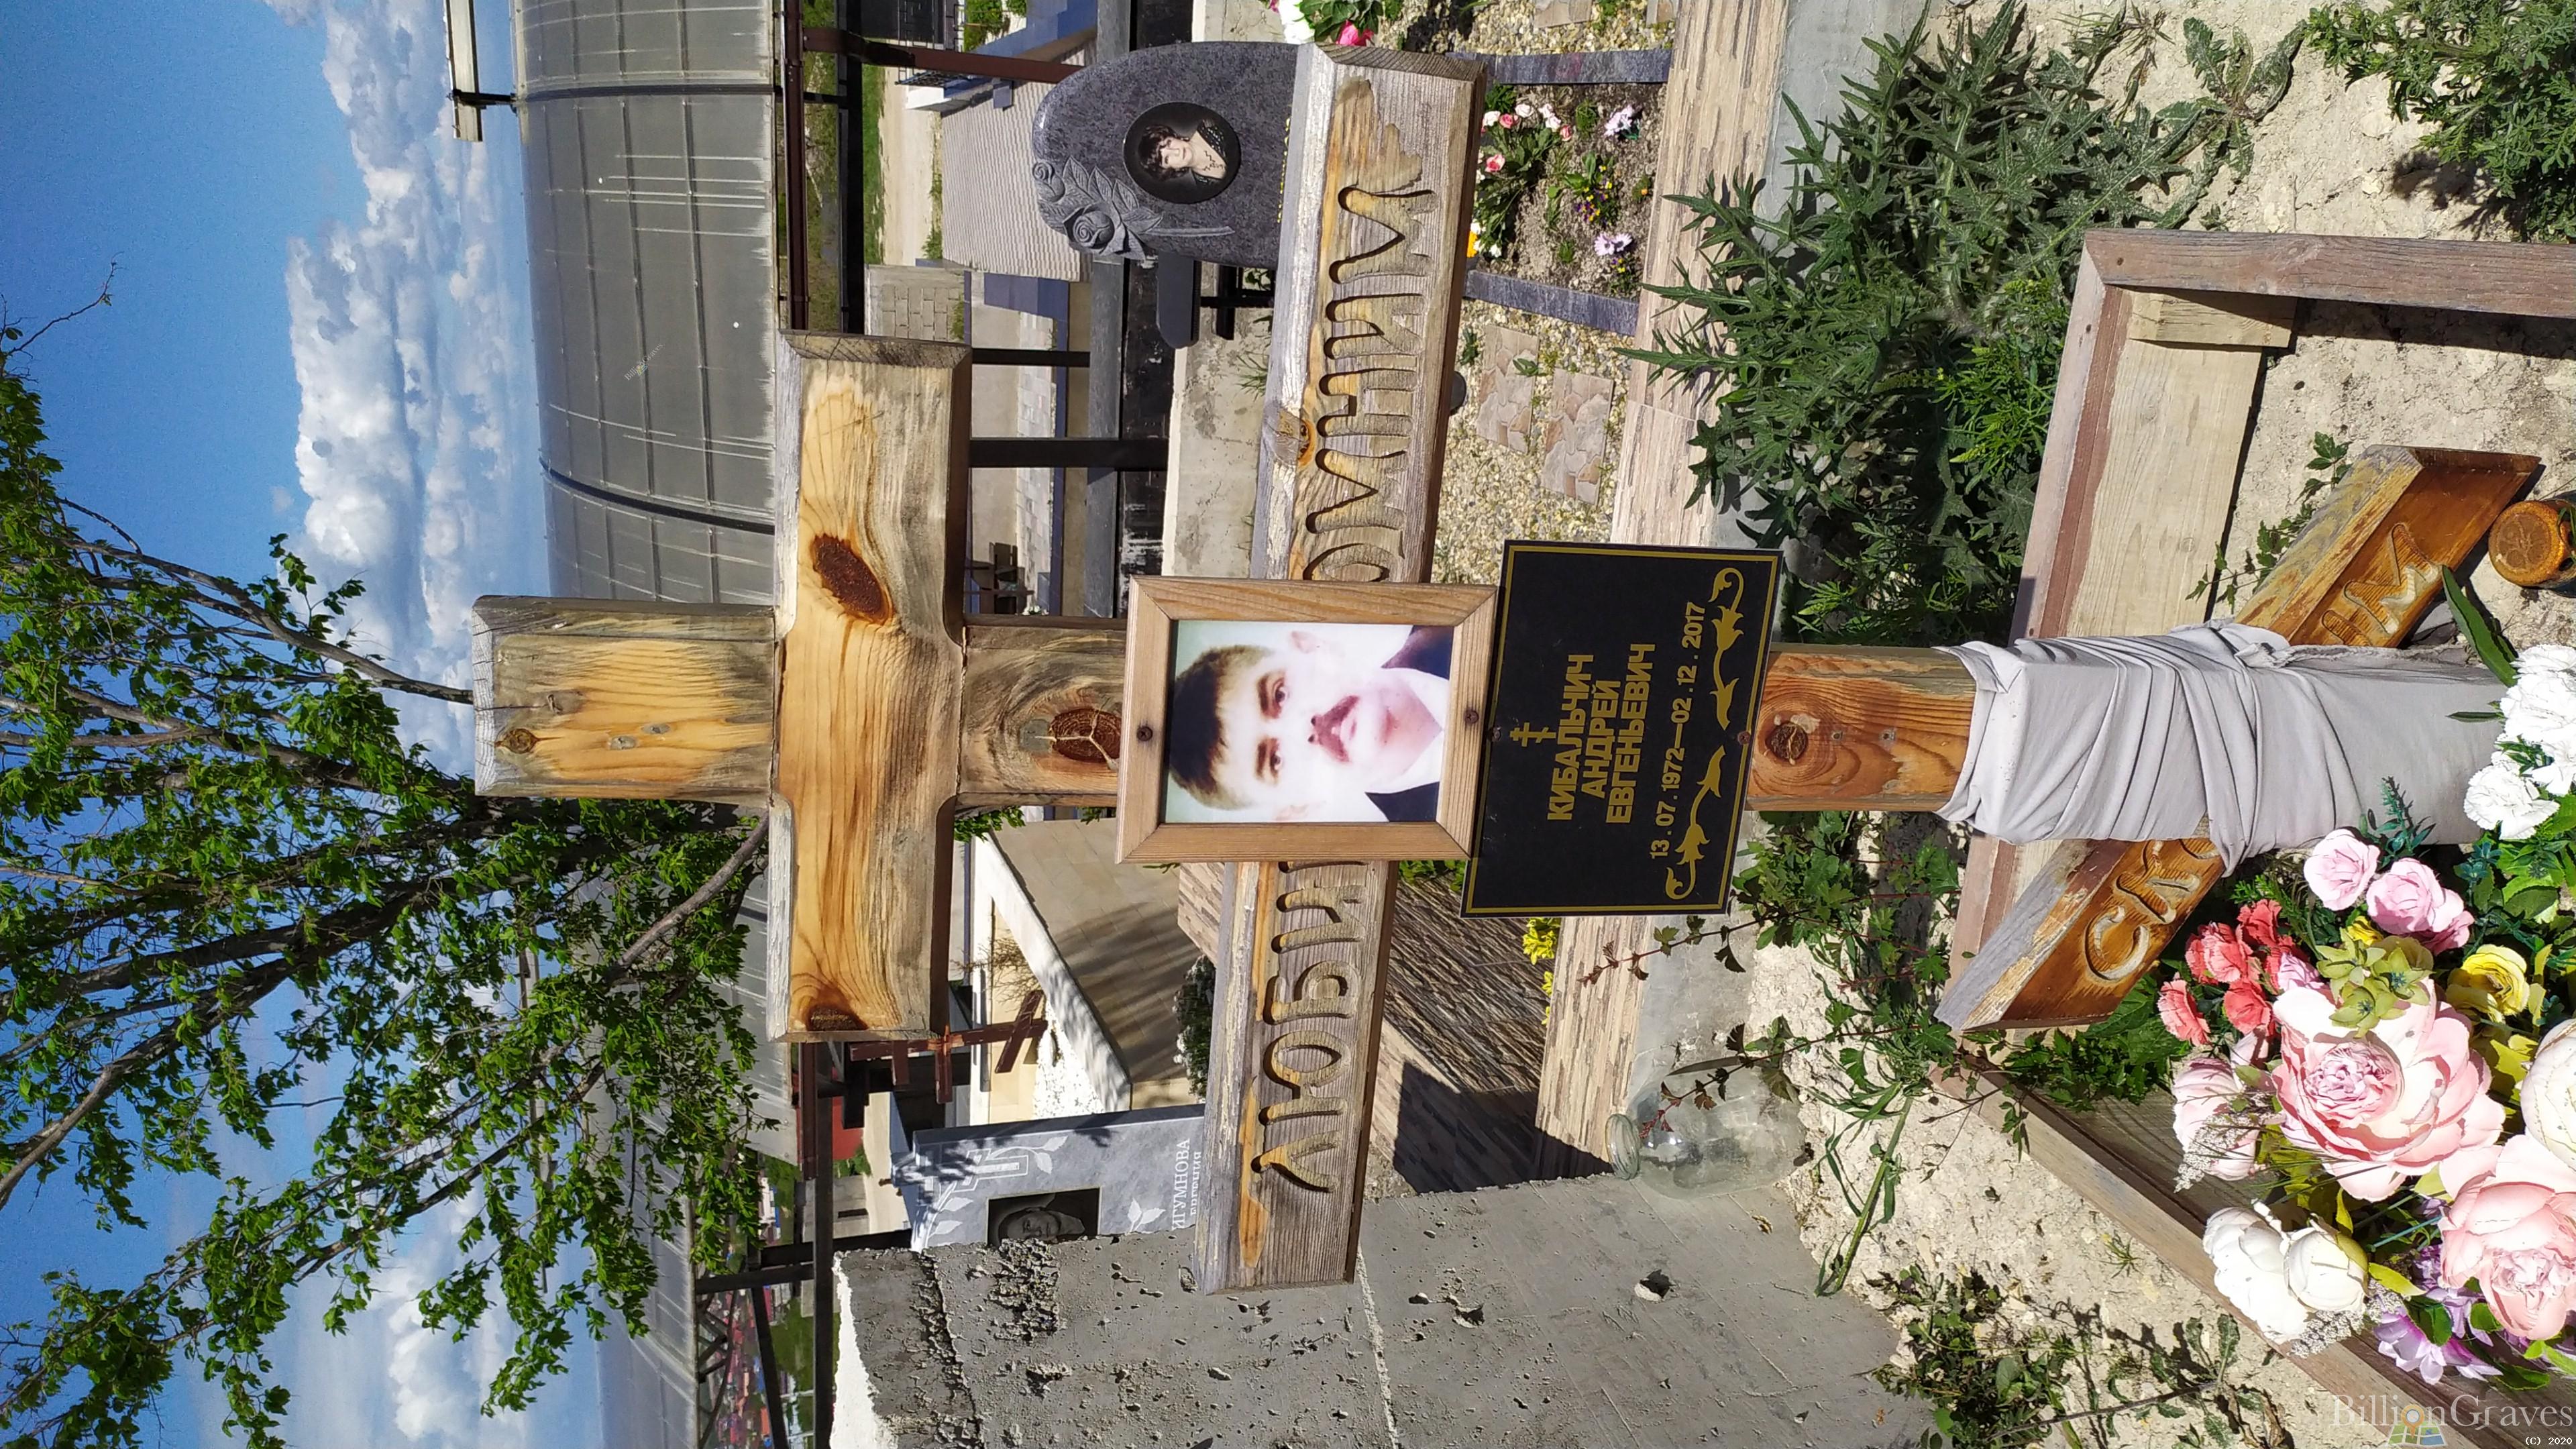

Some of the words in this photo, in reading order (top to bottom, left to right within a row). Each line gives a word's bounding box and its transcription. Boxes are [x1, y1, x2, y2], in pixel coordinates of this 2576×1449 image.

[1302, 186, 1438, 582] ОМНИМ
[1547, 654, 1593, 820] КИБАЛЬЧИЧ
[1582, 680, 1621, 798] АНДРЕЙ
[1607, 644, 1655, 823] ЕВГЕНЬЕВИЧ
[1250, 861, 1368, 1193] ЛЮБИ
